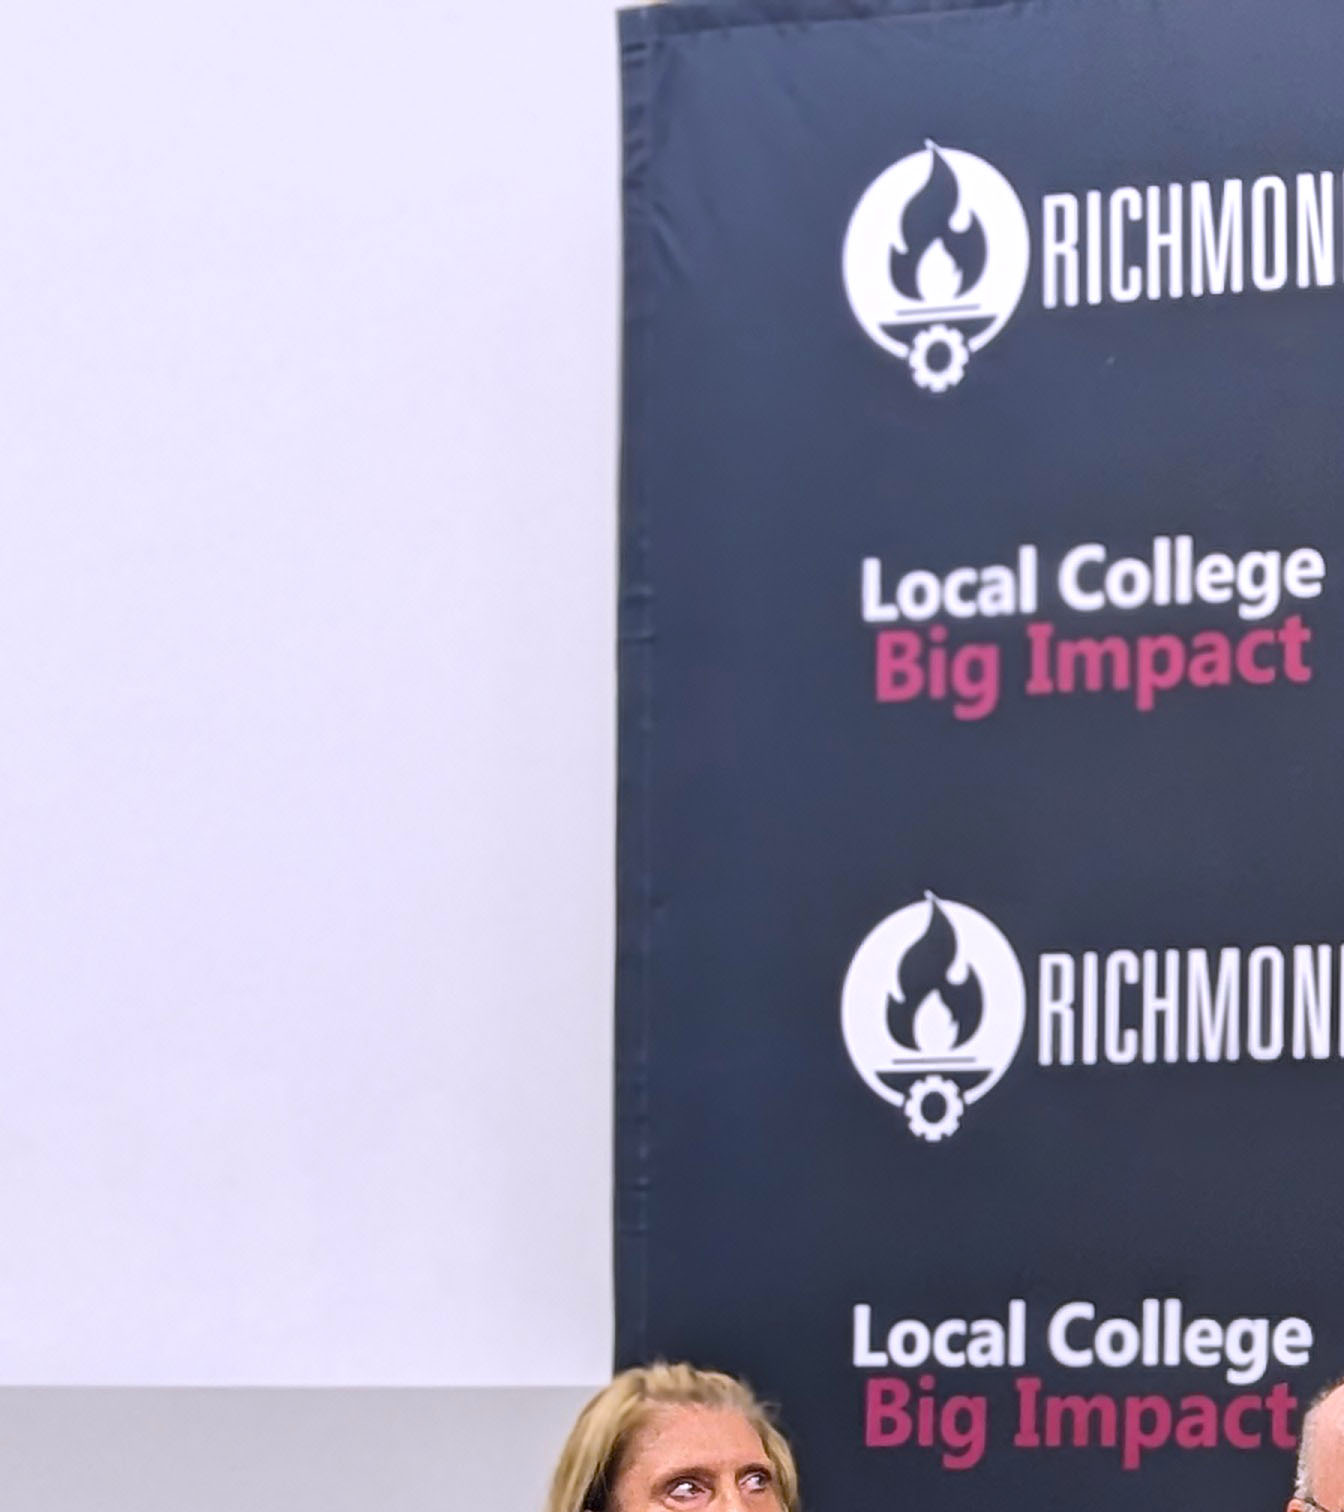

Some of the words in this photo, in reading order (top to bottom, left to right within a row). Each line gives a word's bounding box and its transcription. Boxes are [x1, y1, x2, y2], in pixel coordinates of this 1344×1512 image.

[863, 545, 1037, 622] Local
[1058, 536, 1325, 619] College
[877, 626, 999, 720] Big
[1028, 616, 1310, 710] Impact
[854, 1300, 1025, 1367] Local
[1049, 1299, 1312, 1384] College
[866, 1376, 986, 1469] Big
[1014, 1379, 1297, 1469] Impact
